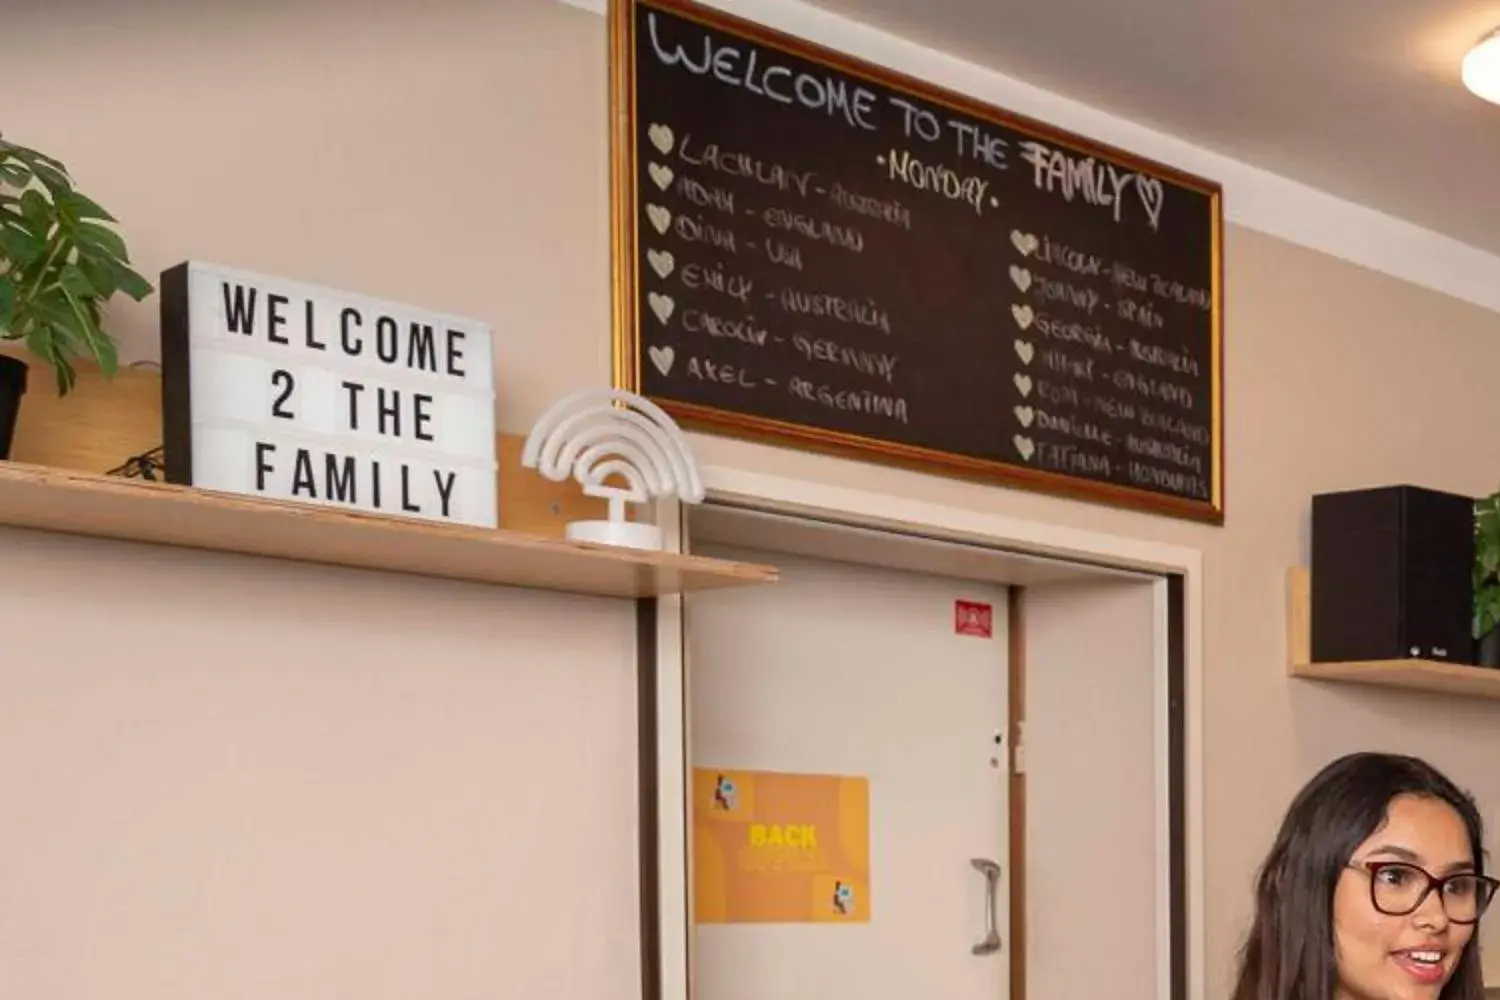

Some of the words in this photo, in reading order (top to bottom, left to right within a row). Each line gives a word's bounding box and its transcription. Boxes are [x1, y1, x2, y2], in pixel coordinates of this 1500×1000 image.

[648, 13, 877, 130] WELCOME
[889, 98, 940, 141] TO
[948, 121, 1009, 169] THE
[1018, 141, 1132, 221] FAMILY
[223, 282, 465, 377] WELCOME
[271, 369, 294, 419] 2
[342, 381, 434, 441] THE
[687, 356, 756, 388] AXEL
[789, 376, 908, 424] ARGENTINA
[255, 441, 456, 516] FAMILY
[750, 824, 817, 848] BACK
